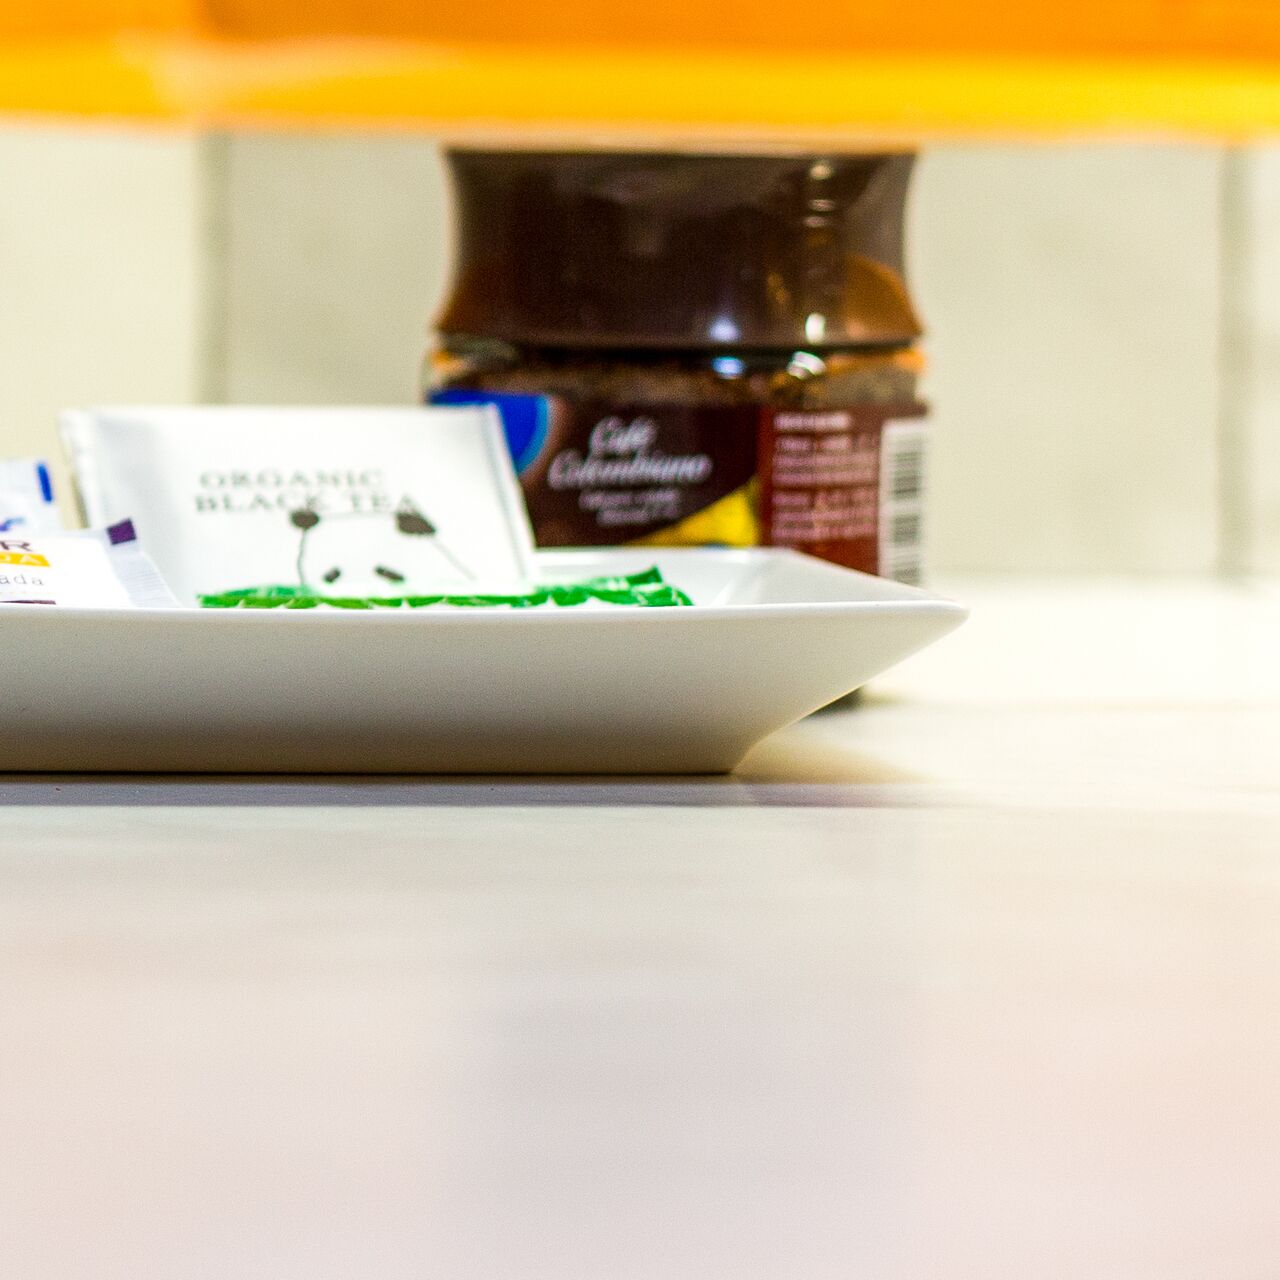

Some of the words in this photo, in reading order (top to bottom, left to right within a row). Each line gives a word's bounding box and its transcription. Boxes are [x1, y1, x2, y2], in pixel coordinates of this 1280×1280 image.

[198, 470, 385, 489] ORGANIC
[194, 492, 328, 514] BLACK
[348, 492, 425, 515] TEA
